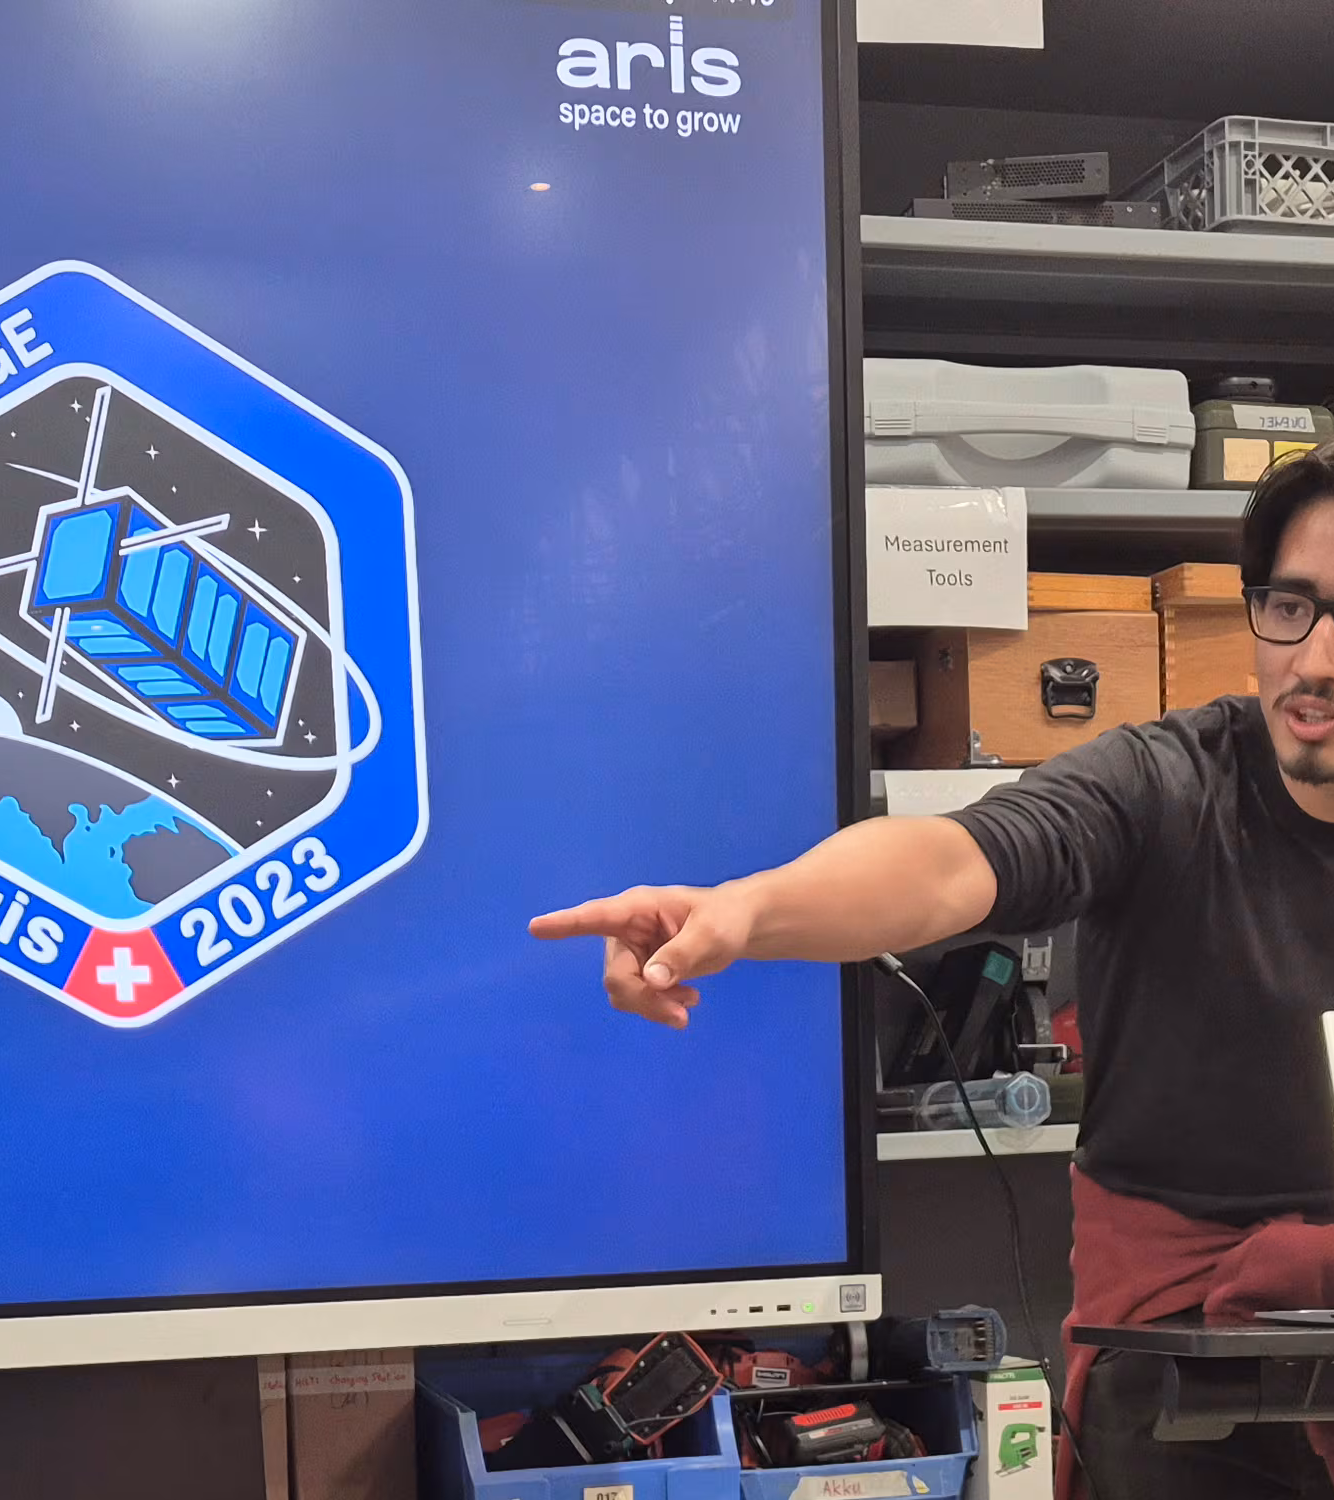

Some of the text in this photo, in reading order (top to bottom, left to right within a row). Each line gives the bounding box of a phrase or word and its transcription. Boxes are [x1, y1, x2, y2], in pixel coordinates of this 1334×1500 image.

[557, 16, 741, 97] aris
[559, 102, 741, 138] space to grow
[884, 535, 1009, 554] Measurement
[926, 569, 973, 587] Tools
[179, 835, 342, 968] 2023
[823, 1479, 862, 1497] Akku
